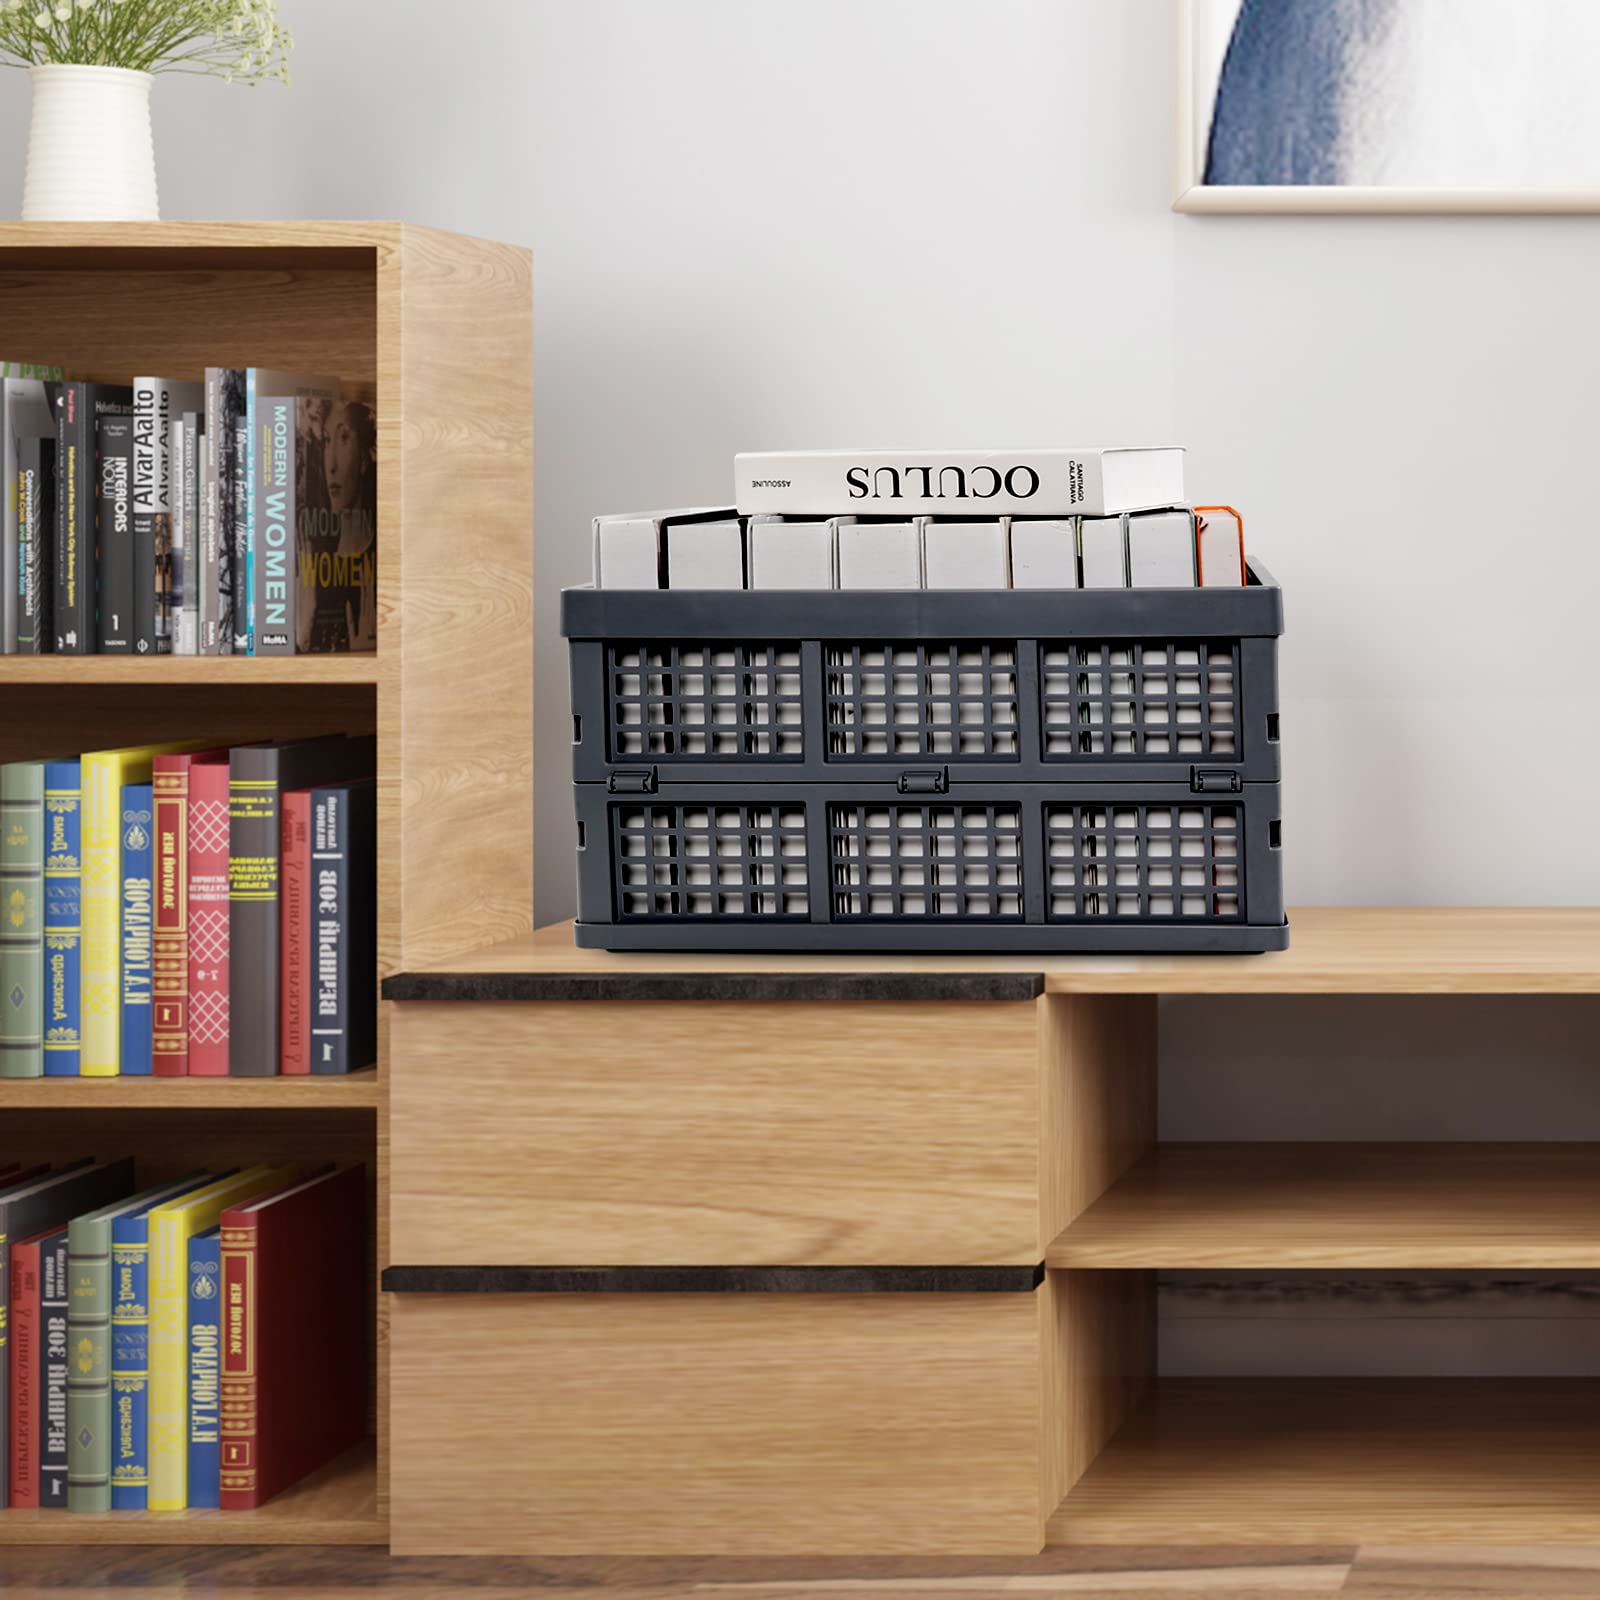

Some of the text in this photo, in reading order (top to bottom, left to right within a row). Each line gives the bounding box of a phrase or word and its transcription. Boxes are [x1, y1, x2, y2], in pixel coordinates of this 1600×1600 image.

[102, 456, 114, 498] NOW!
[185, 427, 194, 511] Picasso Guitars
[751, 479, 792, 489] ASSOULINE
[846, 465, 1040, 499] OCULUS
[1076, 463, 1084, 501] SANTIAGO
[114, 457, 128, 532] INTERIORS
[265, 406, 286, 624] MODERN WOMEN
[304, 508, 372, 536] MODERN
[26, 470, 34, 616] Conversations with Architects
[301, 553, 375, 588] WOMEN
[112, 614, 118, 630] 1
[264, 636, 286, 644] MoMA
